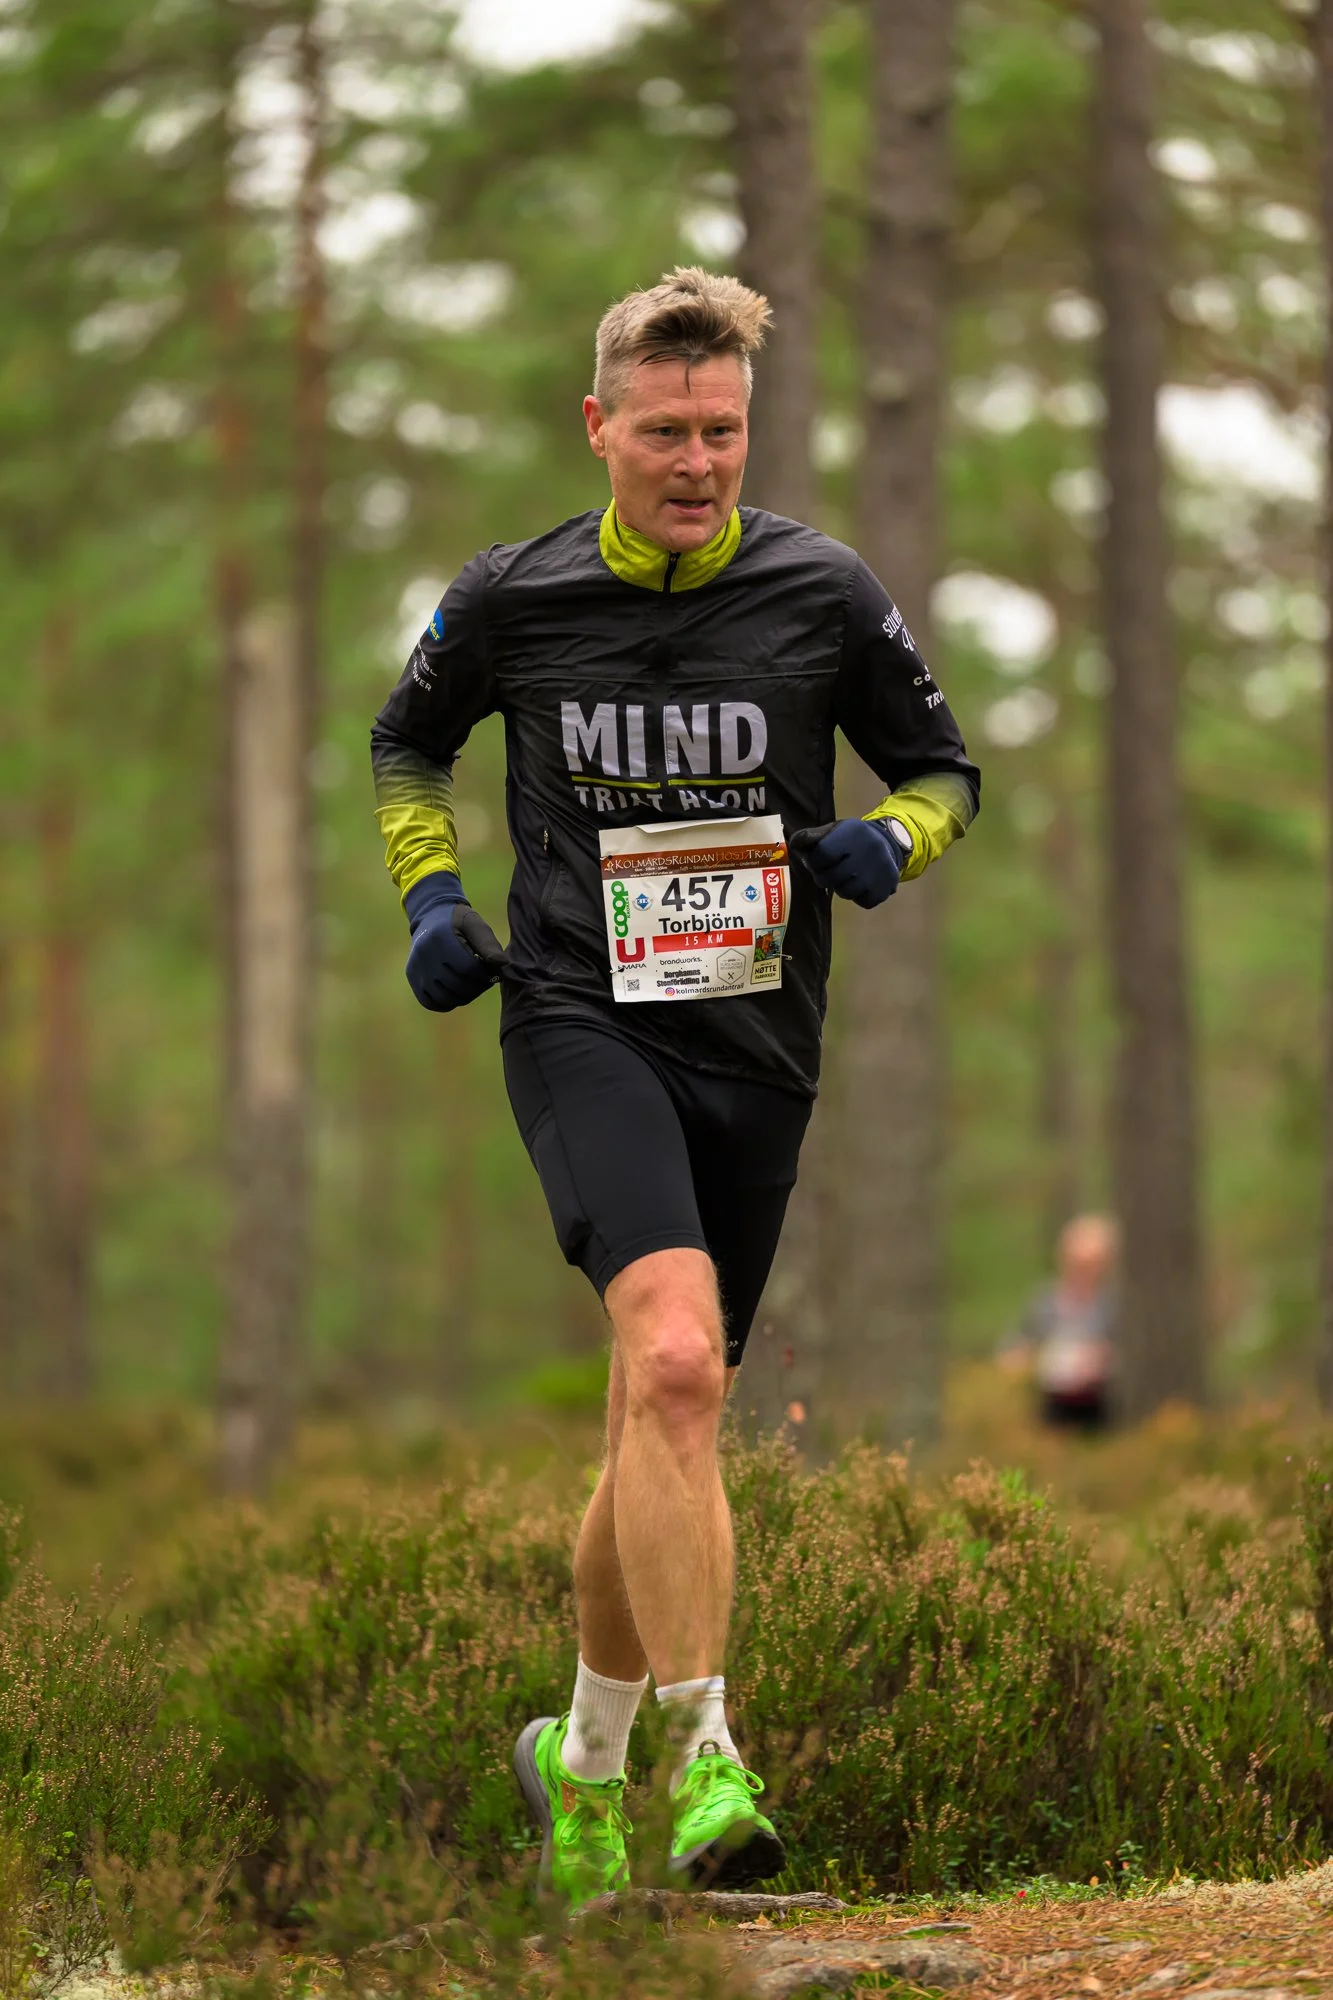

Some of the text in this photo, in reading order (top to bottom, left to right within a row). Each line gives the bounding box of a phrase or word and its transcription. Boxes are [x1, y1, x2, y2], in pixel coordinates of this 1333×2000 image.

[561, 701, 768, 778] MIND
[611, 881, 629, 938] coop
[661, 873, 734, 912] 457
[770, 888, 779, 920] CIRCLE
[658, 913, 744, 934] Torbjörn
[685, 934, 723, 946] 15 KM
